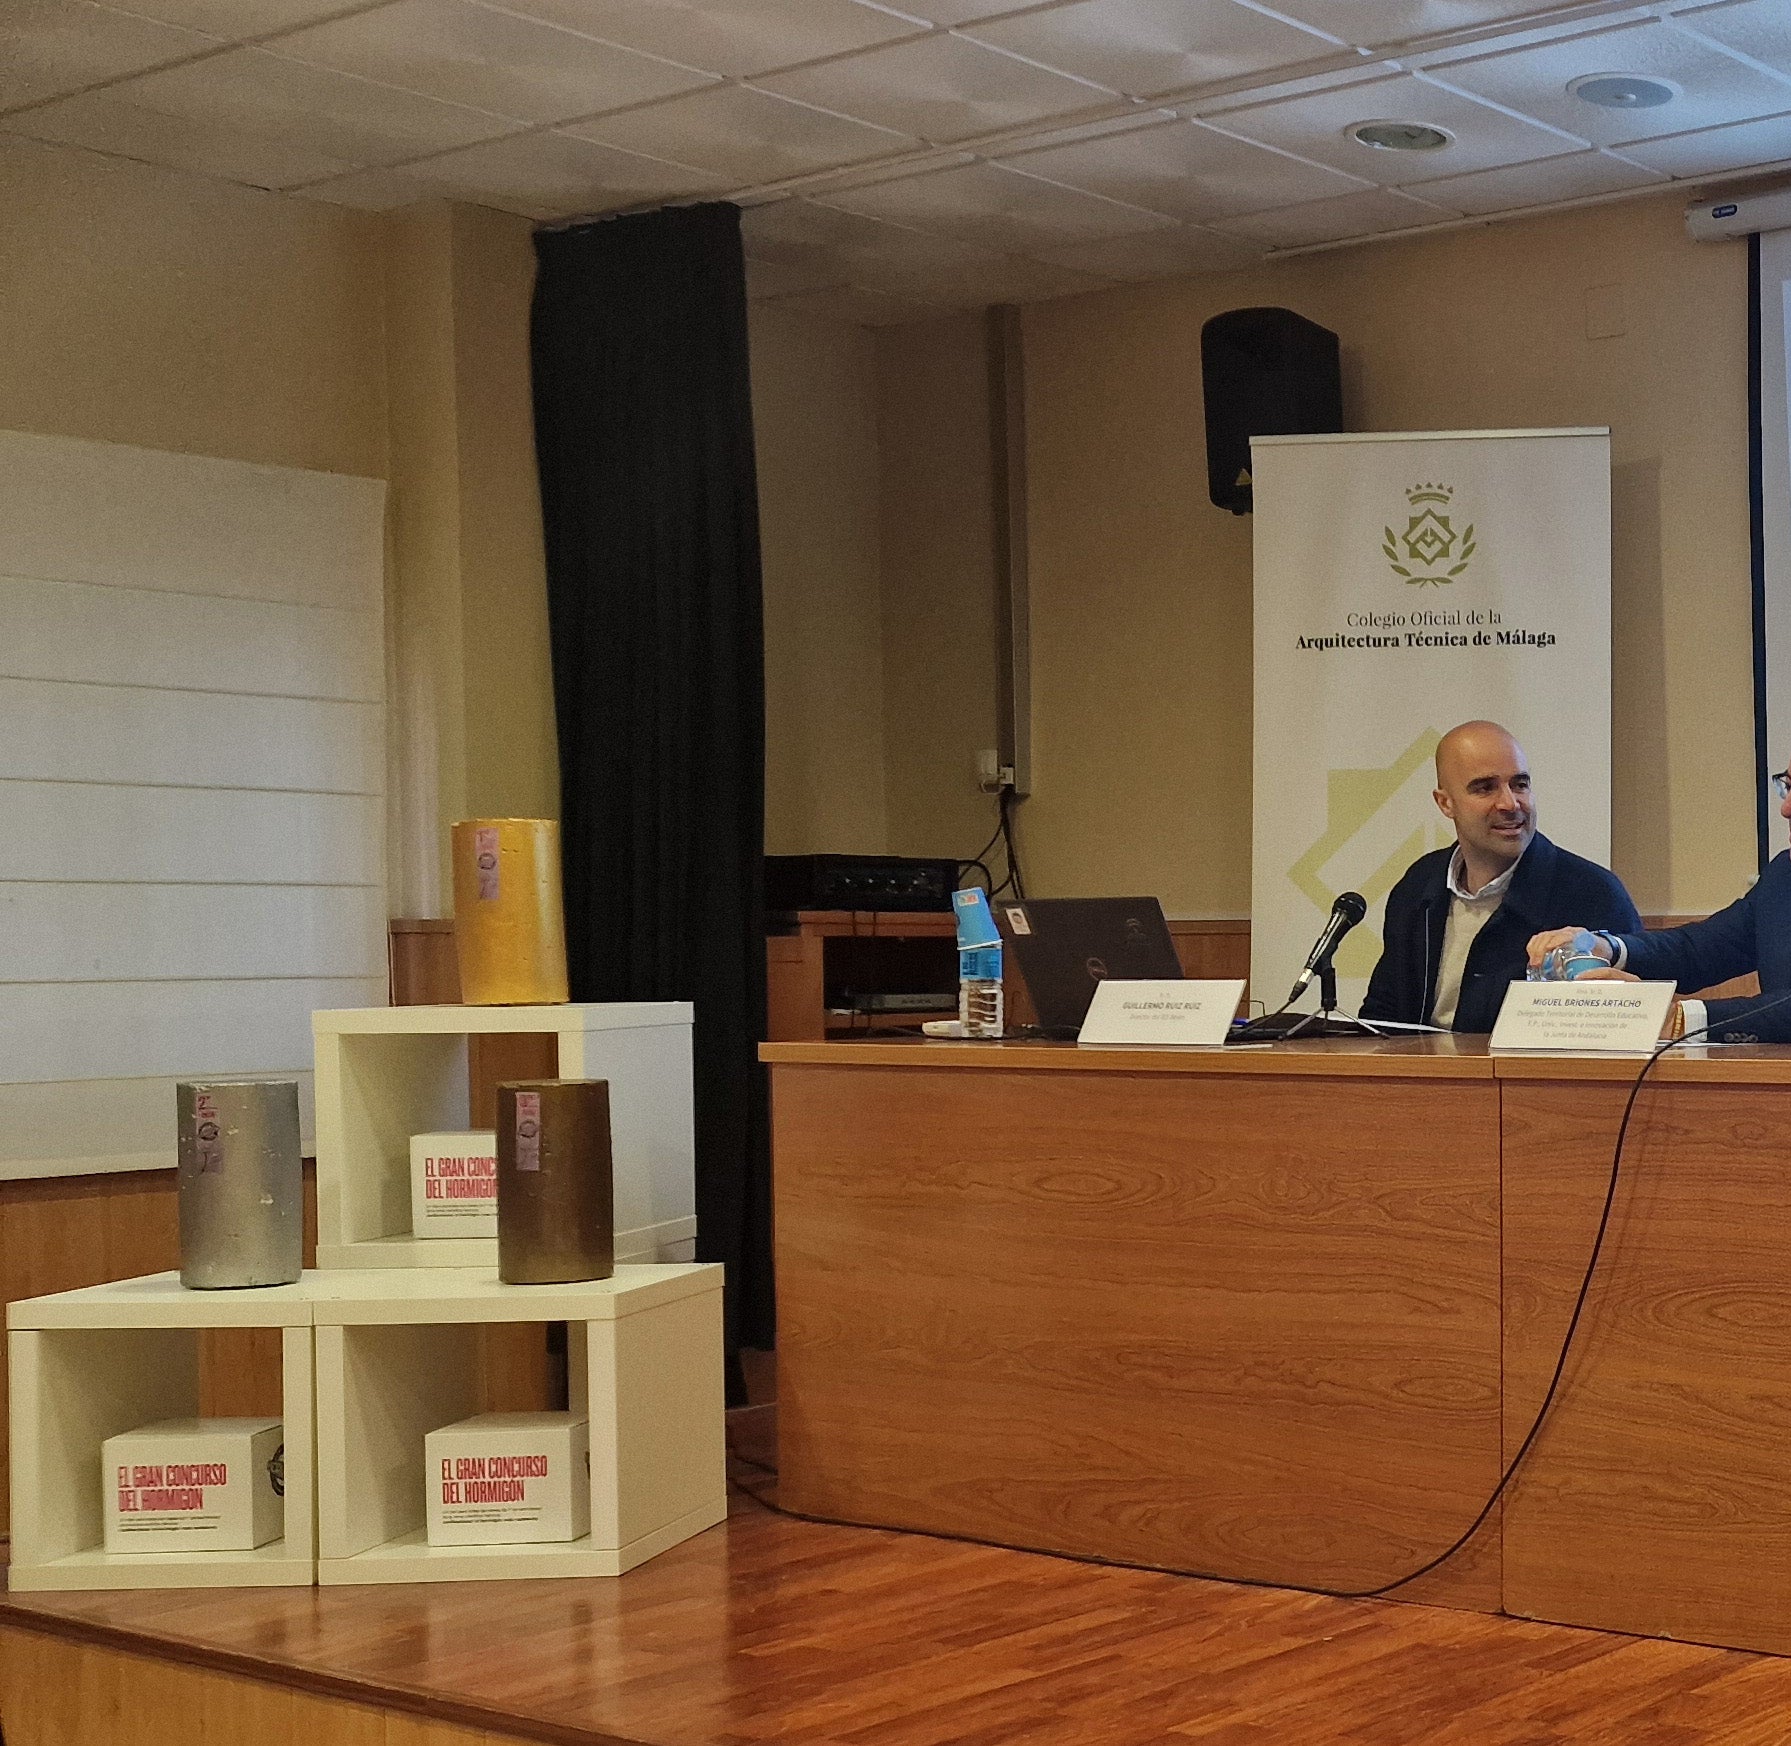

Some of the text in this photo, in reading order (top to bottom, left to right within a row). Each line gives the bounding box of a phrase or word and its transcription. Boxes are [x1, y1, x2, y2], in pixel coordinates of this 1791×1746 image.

[1347, 609, 1502, 629] Colegio Oficial de la
[1295, 630, 1557, 650] Arquitectura Técnica de Málaga
[1532, 998, 1641, 1008] MIGUEL BRIONES ARTACHO
[425, 1157, 436, 1177] EL
[439, 1157, 464, 1177] GRAN
[426, 1179, 444, 1198] DEL
[118, 1466, 131, 1488] EL
[166, 1463, 227, 1486] CONCURSO
[442, 1455, 547, 1480] EL GRAN CONCURSO
[118, 1489, 138, 1512] DEL
[442, 1481, 462, 1504] DEL
